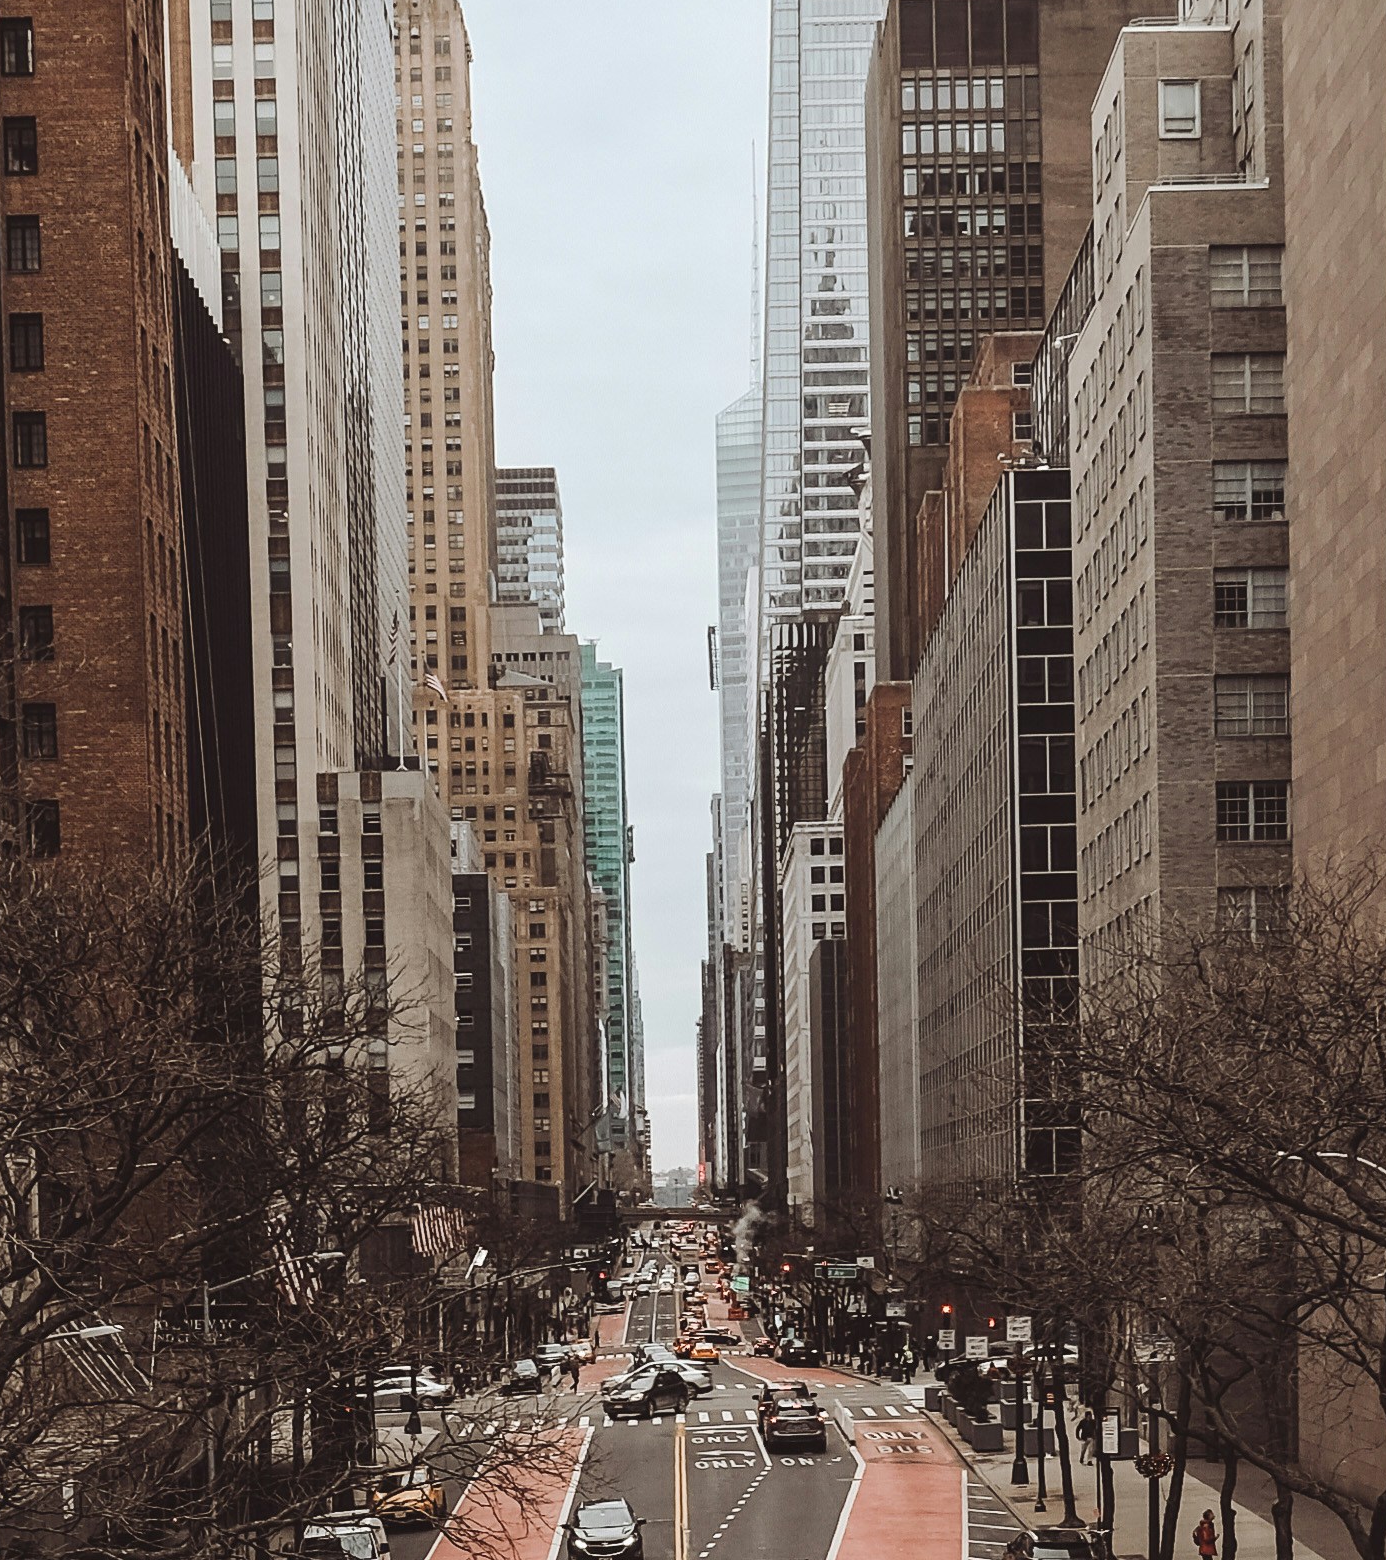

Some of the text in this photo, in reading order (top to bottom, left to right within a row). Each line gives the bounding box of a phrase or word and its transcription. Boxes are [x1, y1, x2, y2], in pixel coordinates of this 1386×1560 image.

[691, 1434, 749, 1444] ONLY
[864, 1431, 924, 1441] ONLY
[878, 1444, 935, 1454] BUS
[694, 1458, 757, 1470] ONLY
